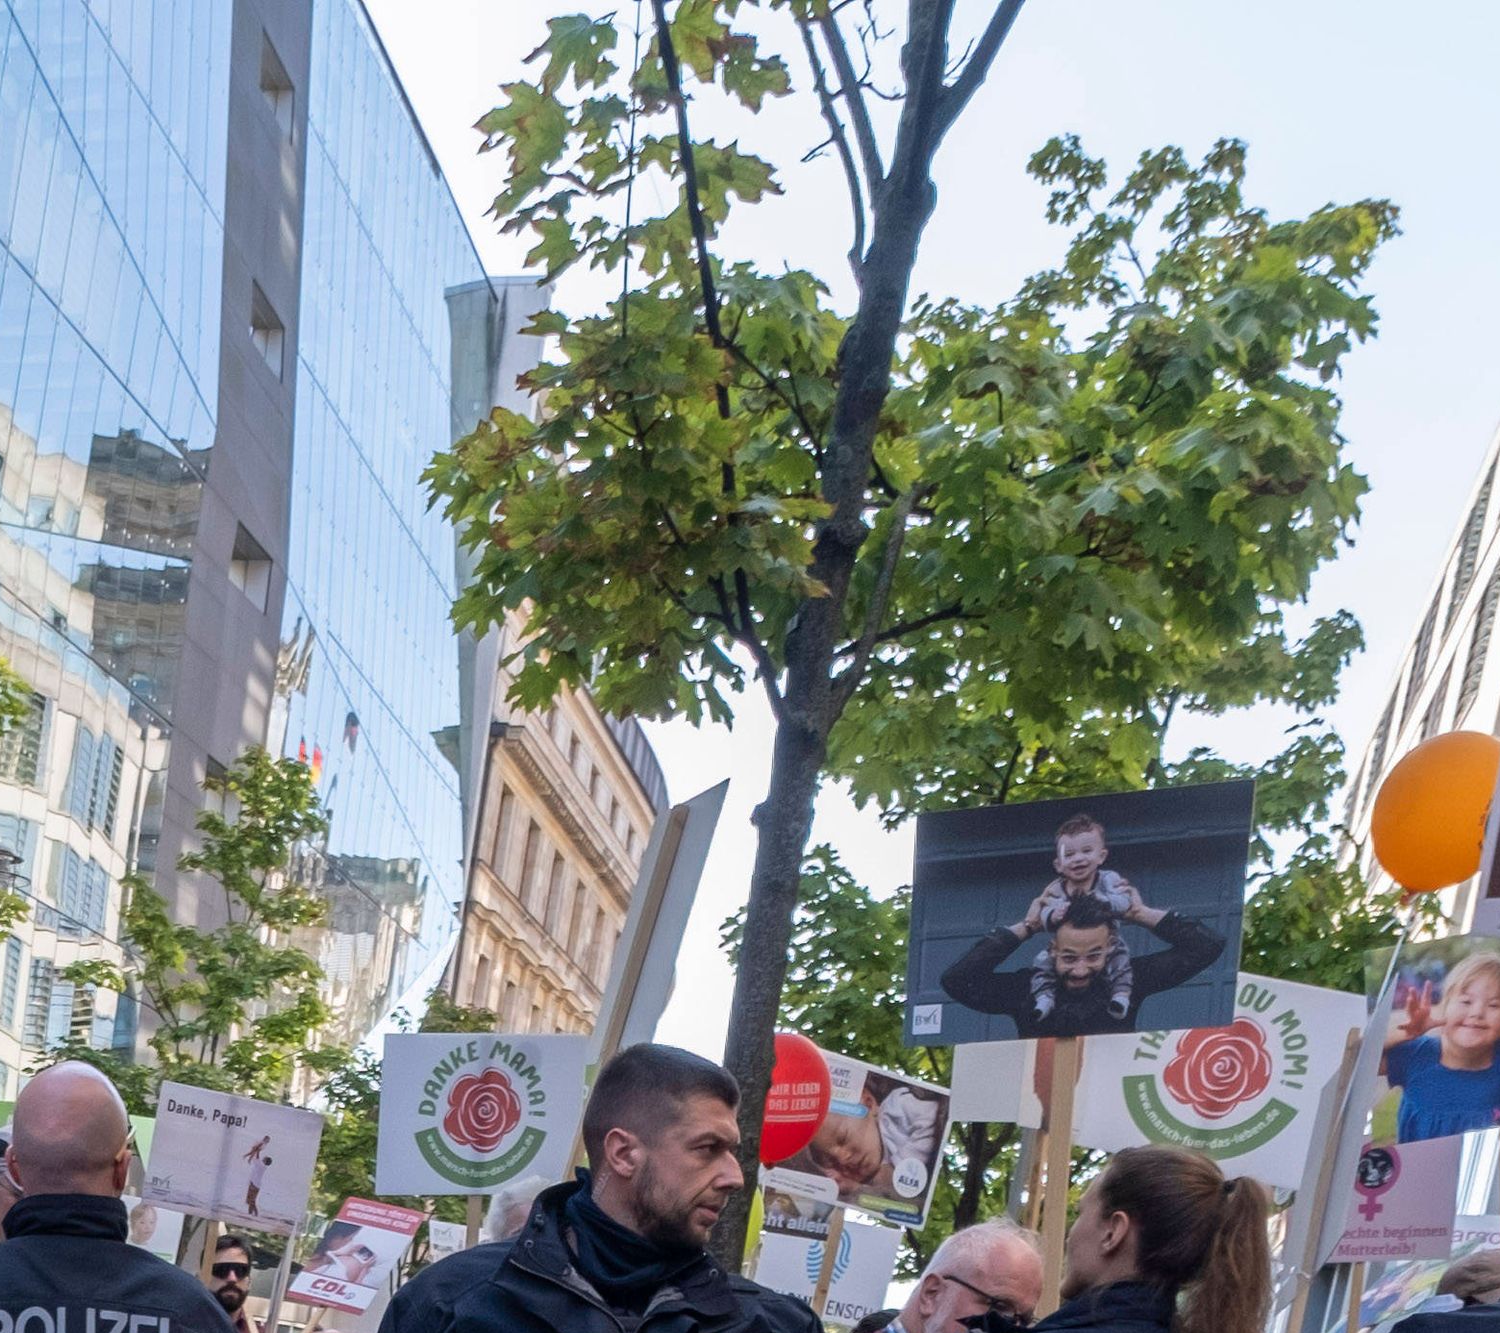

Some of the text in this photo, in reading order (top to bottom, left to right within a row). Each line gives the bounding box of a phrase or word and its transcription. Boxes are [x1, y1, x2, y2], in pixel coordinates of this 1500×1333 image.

[1238, 983, 1310, 1090] OU MOM!
[418, 1040, 547, 1118] DANKE MAMA!
[167, 1099, 248, 1128] Danke, Papa!
[1343, 1225, 1449, 1241] echte beginnen
[311, 1278, 348, 1296] CDL
